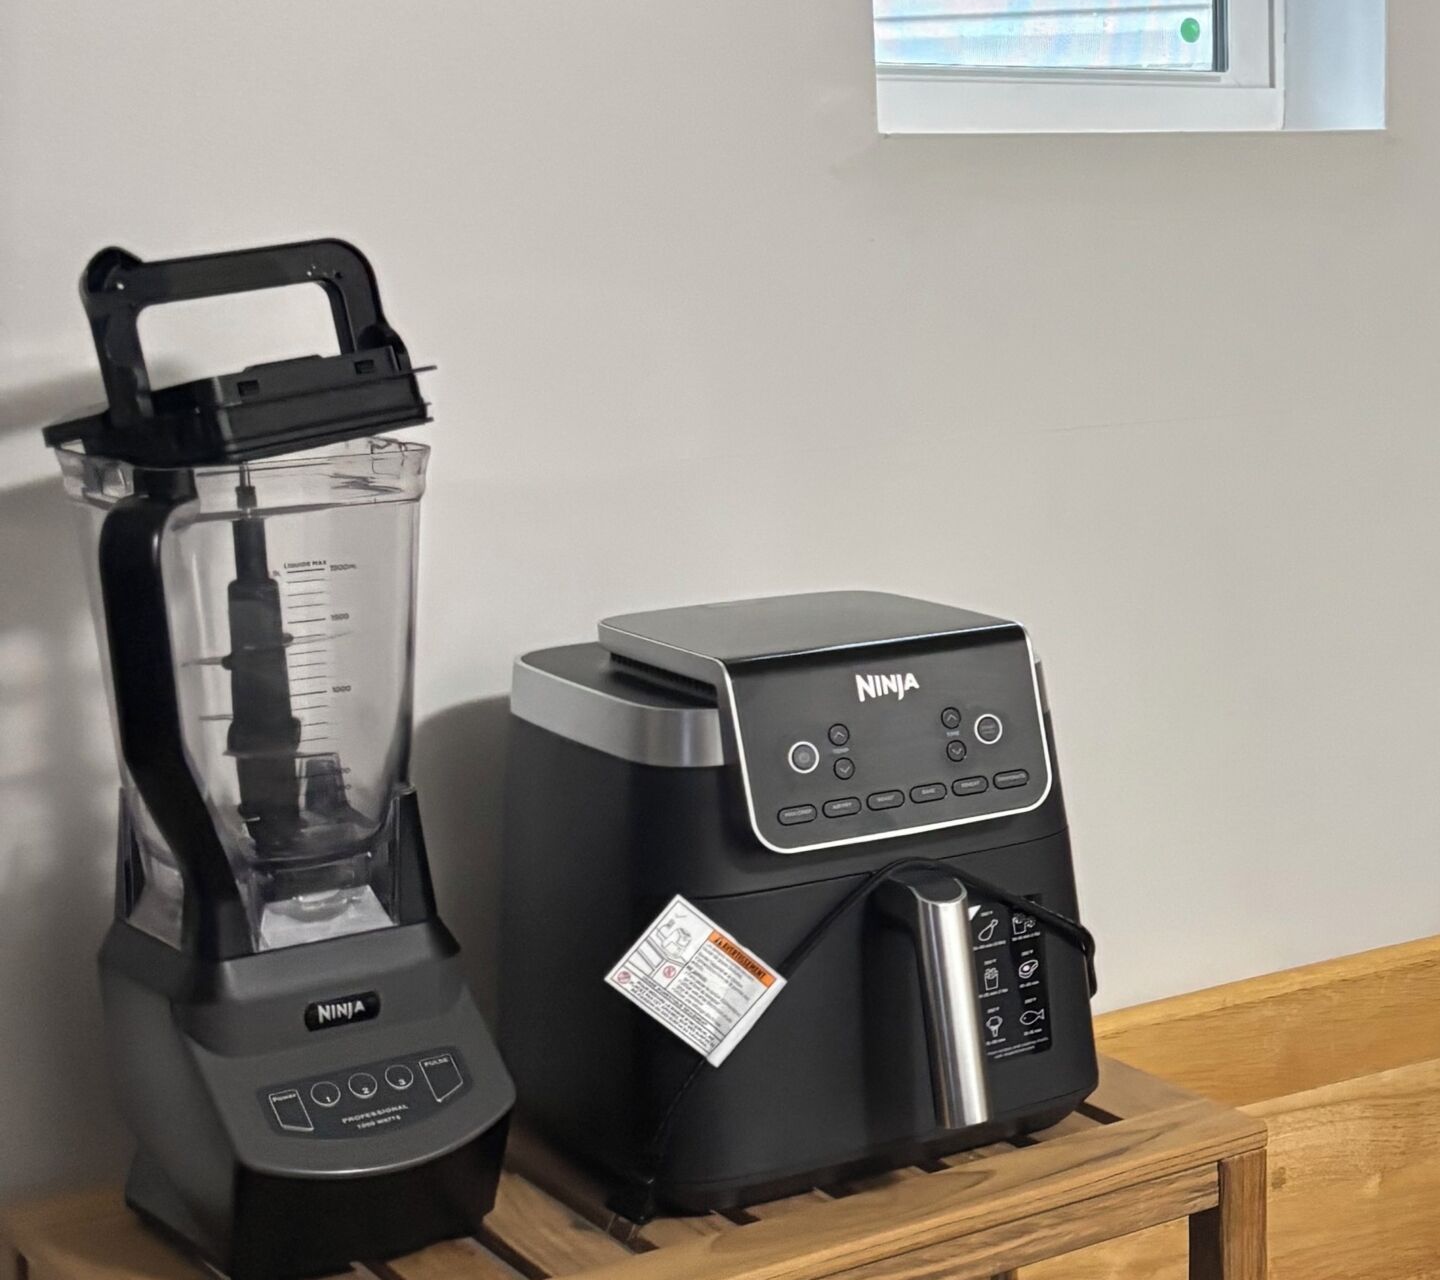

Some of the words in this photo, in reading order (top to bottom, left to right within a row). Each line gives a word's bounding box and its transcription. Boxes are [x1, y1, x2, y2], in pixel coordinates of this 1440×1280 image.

[855, 672, 920, 703] NINJA
[317, 1000, 366, 1024] NINJA
[341, 1104, 409, 1124] PROFESSIONAL
